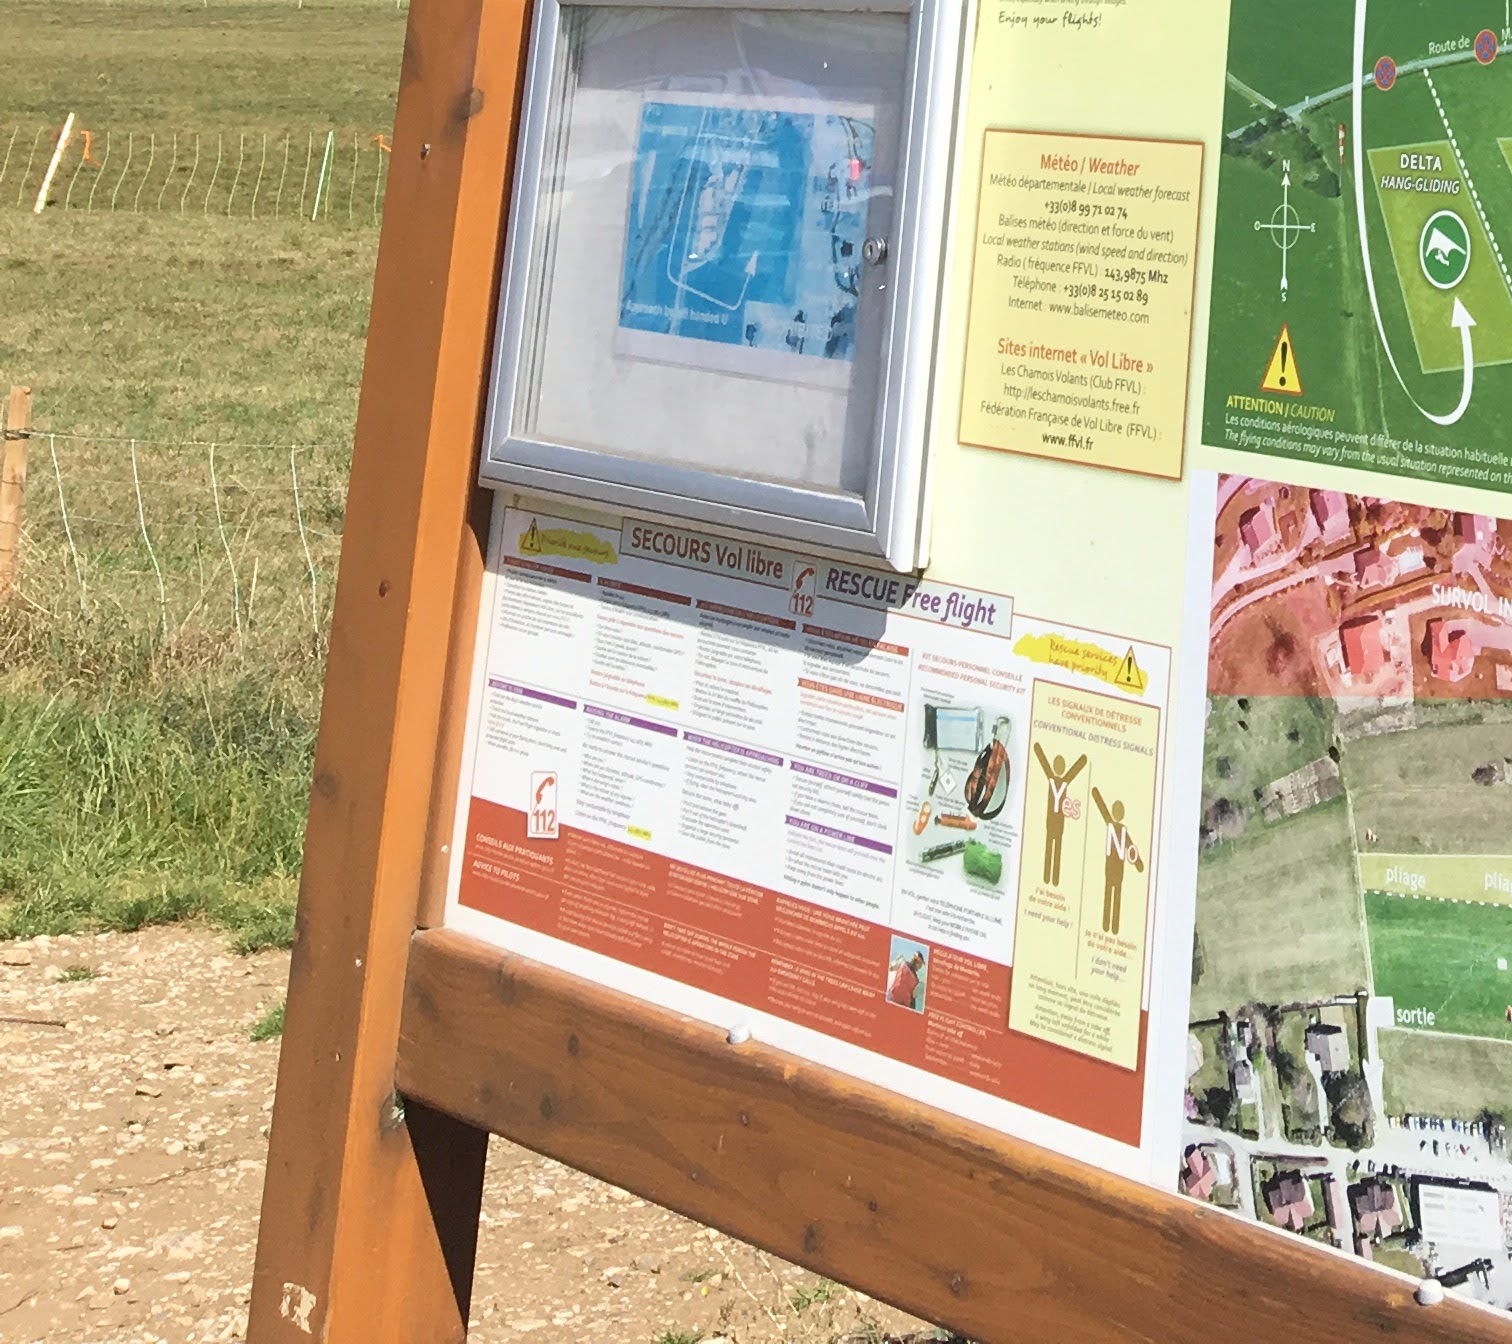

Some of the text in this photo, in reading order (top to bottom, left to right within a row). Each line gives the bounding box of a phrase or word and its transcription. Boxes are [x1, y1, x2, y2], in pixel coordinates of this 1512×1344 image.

[998, 11, 1102, 30] Enjoy your flights!
[1428, 38, 1456, 55] Route
[1458, 36, 1470, 50] de
[1040, 153, 1078, 172] Météo
[1088, 157, 1140, 176] Weather
[1282, 160, 1290, 170] N
[1400, 154, 1442, 172] DELTA
[990, 174, 1017, 187] Météo
[1019, 176, 1086, 193] départementale
[1093, 182, 1115, 195] Local
[1117, 186, 1152, 198] weather
[1152, 187, 1190, 202] forecast
[1380, 175, 1460, 194] HANG-GLIDING
[1045, 200, 1128, 220] +33(0)8 99 71 02 74
[999, 214, 1173, 242] Balises météo (direction et force du vent)
[1281, 292, 1287, 302] S
[998, 337, 1026, 357] Sites
[1029, 341, 1077, 364] internet
[1090, 349, 1109, 368] Vol
[1111, 352, 1143, 373] Libre
[1226, 395, 1283, 416] ATTENTION
[1291, 404, 1335, 422] CAUTION
[1042, 432, 1093, 450] www.ffvl.fr
[632, 527, 711, 562] SECOURS
[716, 545, 742, 571] Vol
[746, 551, 783, 579] libre
[793, 593, 813, 615] 112
[826, 568, 996, 628] RESCUE Free flight
[1432, 584, 1491, 614] SURVOL
[1050, 639, 1118, 666] Rescue services
[1034, 720, 1153, 757] CONVENTIONAL DISTRESS SIGNALS
[1049, 780, 1081, 820] Yes
[532, 810, 556, 832] 112
[1106, 826, 1138, 864] No
[1386, 866, 1426, 891] pliage
[1396, 1006, 1435, 1027] sortie
